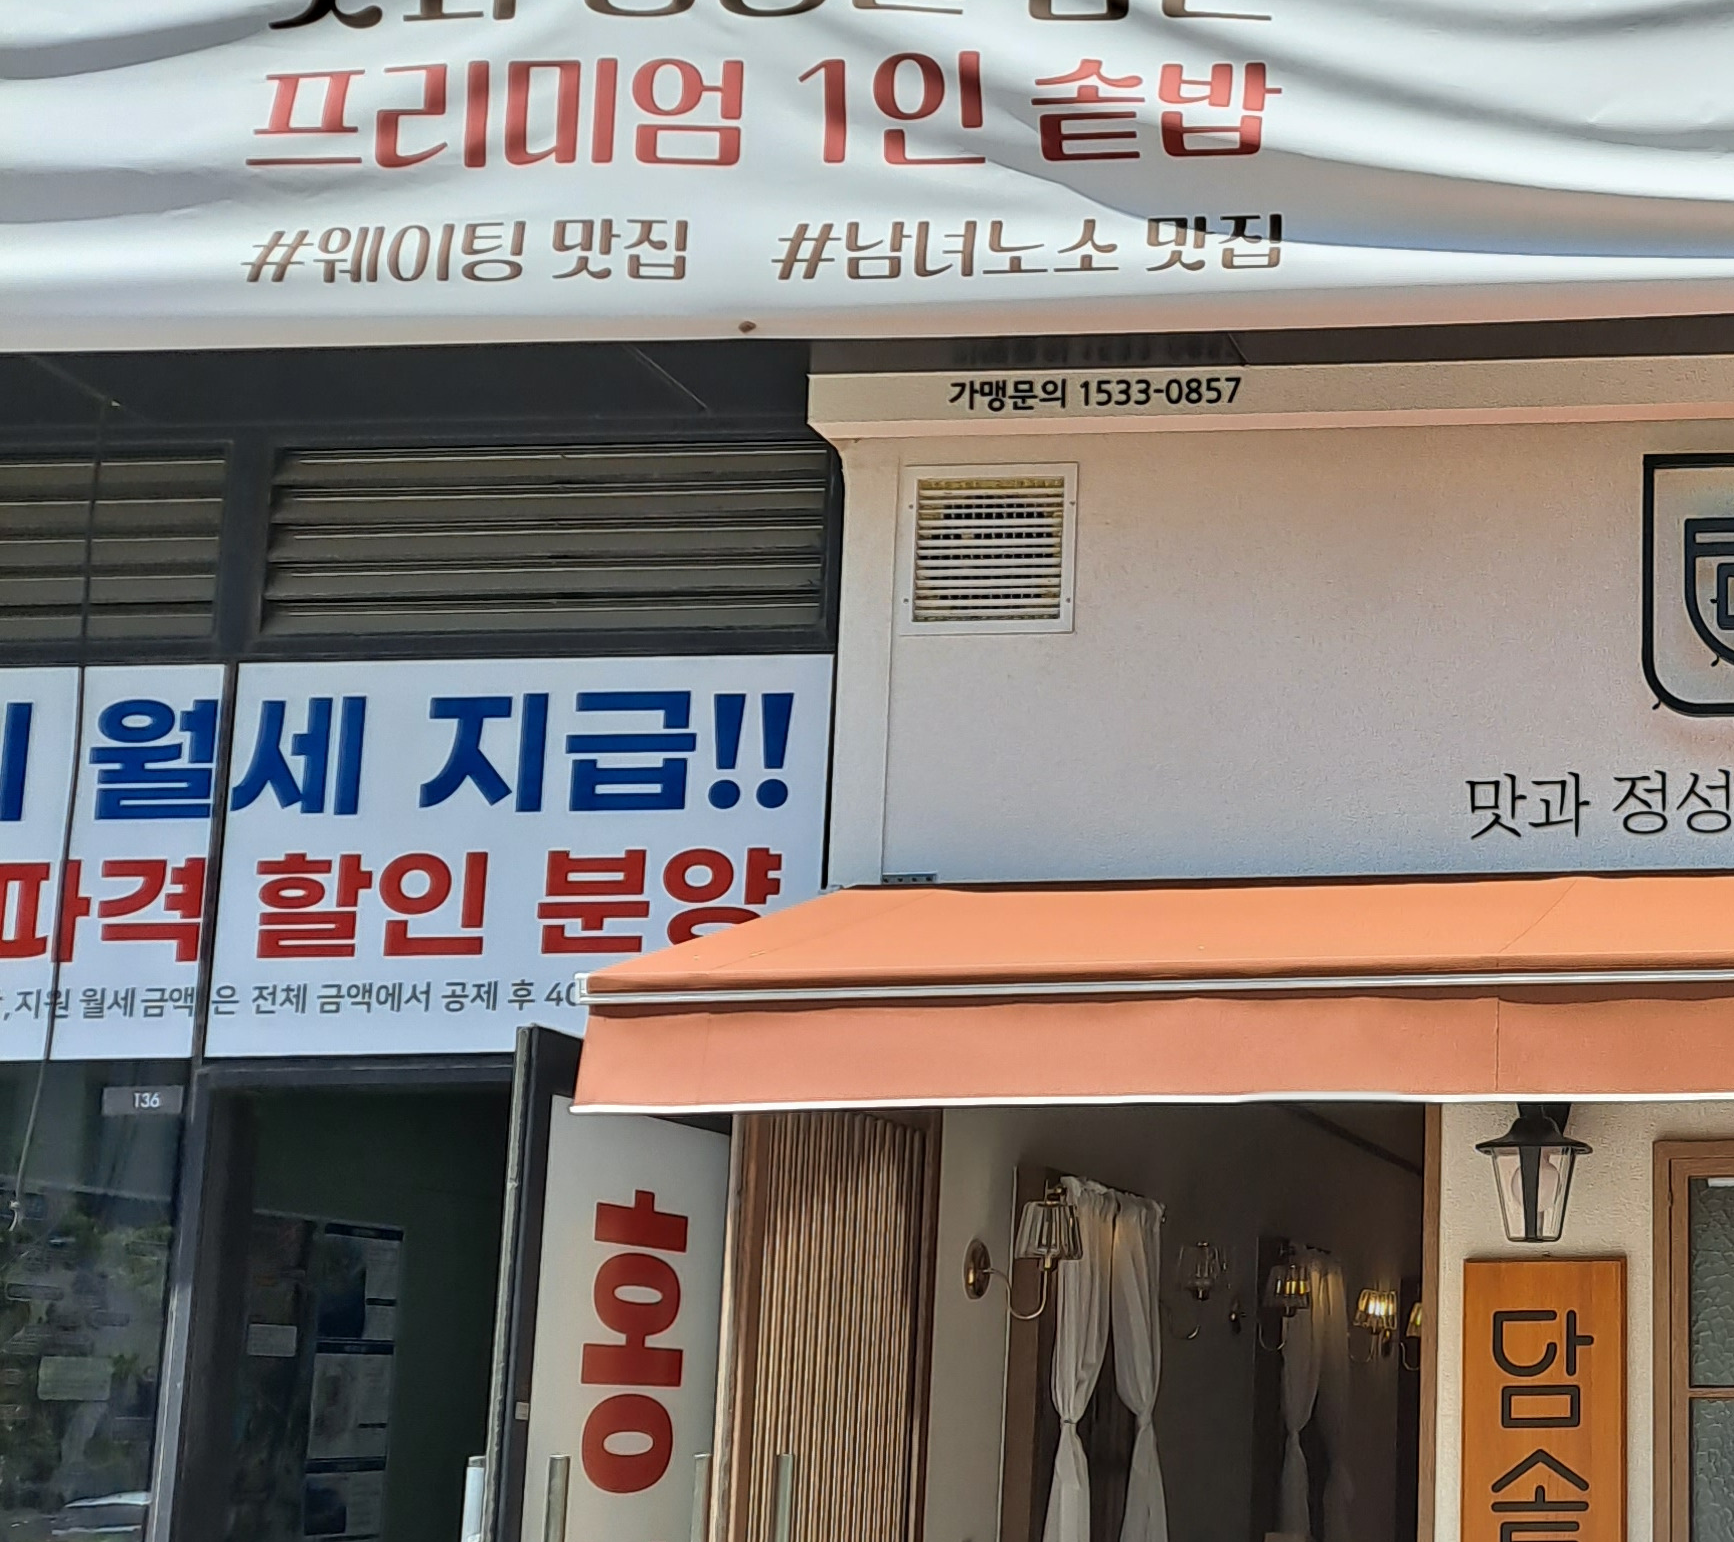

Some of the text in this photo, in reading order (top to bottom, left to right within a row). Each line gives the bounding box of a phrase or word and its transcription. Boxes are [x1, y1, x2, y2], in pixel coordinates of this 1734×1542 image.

[245, 49, 1283, 170] 프리미엄 1인 솥밥
[242, 212, 1283, 285] #웨이팅 맛집 #남녀노소 맛집
[948, 376, 1242, 412] 가맹문의 1533-0857
[89, 695, 368, 820] 월세
[418, 690, 796, 814] 지급!!
[1465, 769, 1591, 843] 맛과
[256, 851, 489, 959] 할인
[537, 846, 783, 955] 분양
[251, 982, 308, 1015] 전체
[316, 981, 433, 1015] 금액에서
[441, 979, 499, 1012] 공제
[507, 979, 537, 1011] 후
